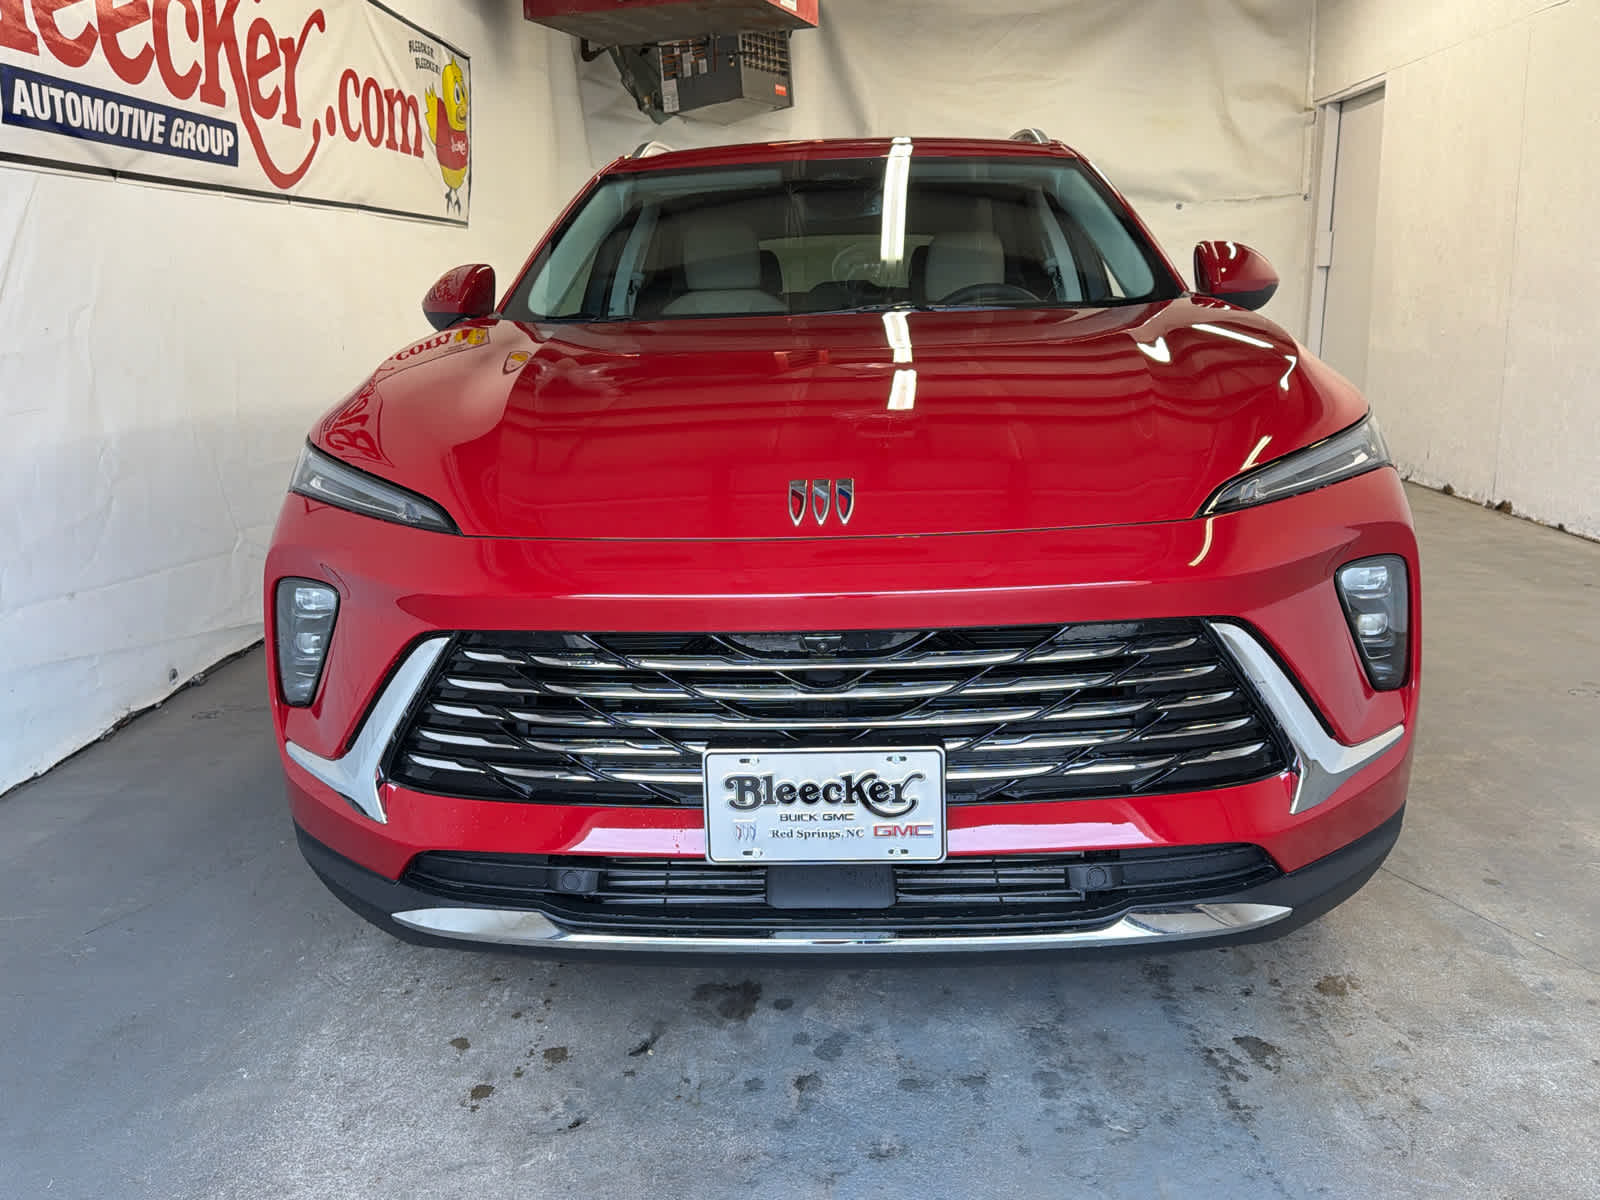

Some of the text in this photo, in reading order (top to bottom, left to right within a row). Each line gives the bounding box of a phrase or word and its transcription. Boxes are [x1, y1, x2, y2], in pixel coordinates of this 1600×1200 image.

[12, 78, 235, 157] AUTOMOTIVE GROUP
[779, 813, 855, 822] BUICK GMC
[771, 829, 793, 838] Red
[846, 828, 864, 838] NC
[873, 824, 934, 839] GMC
